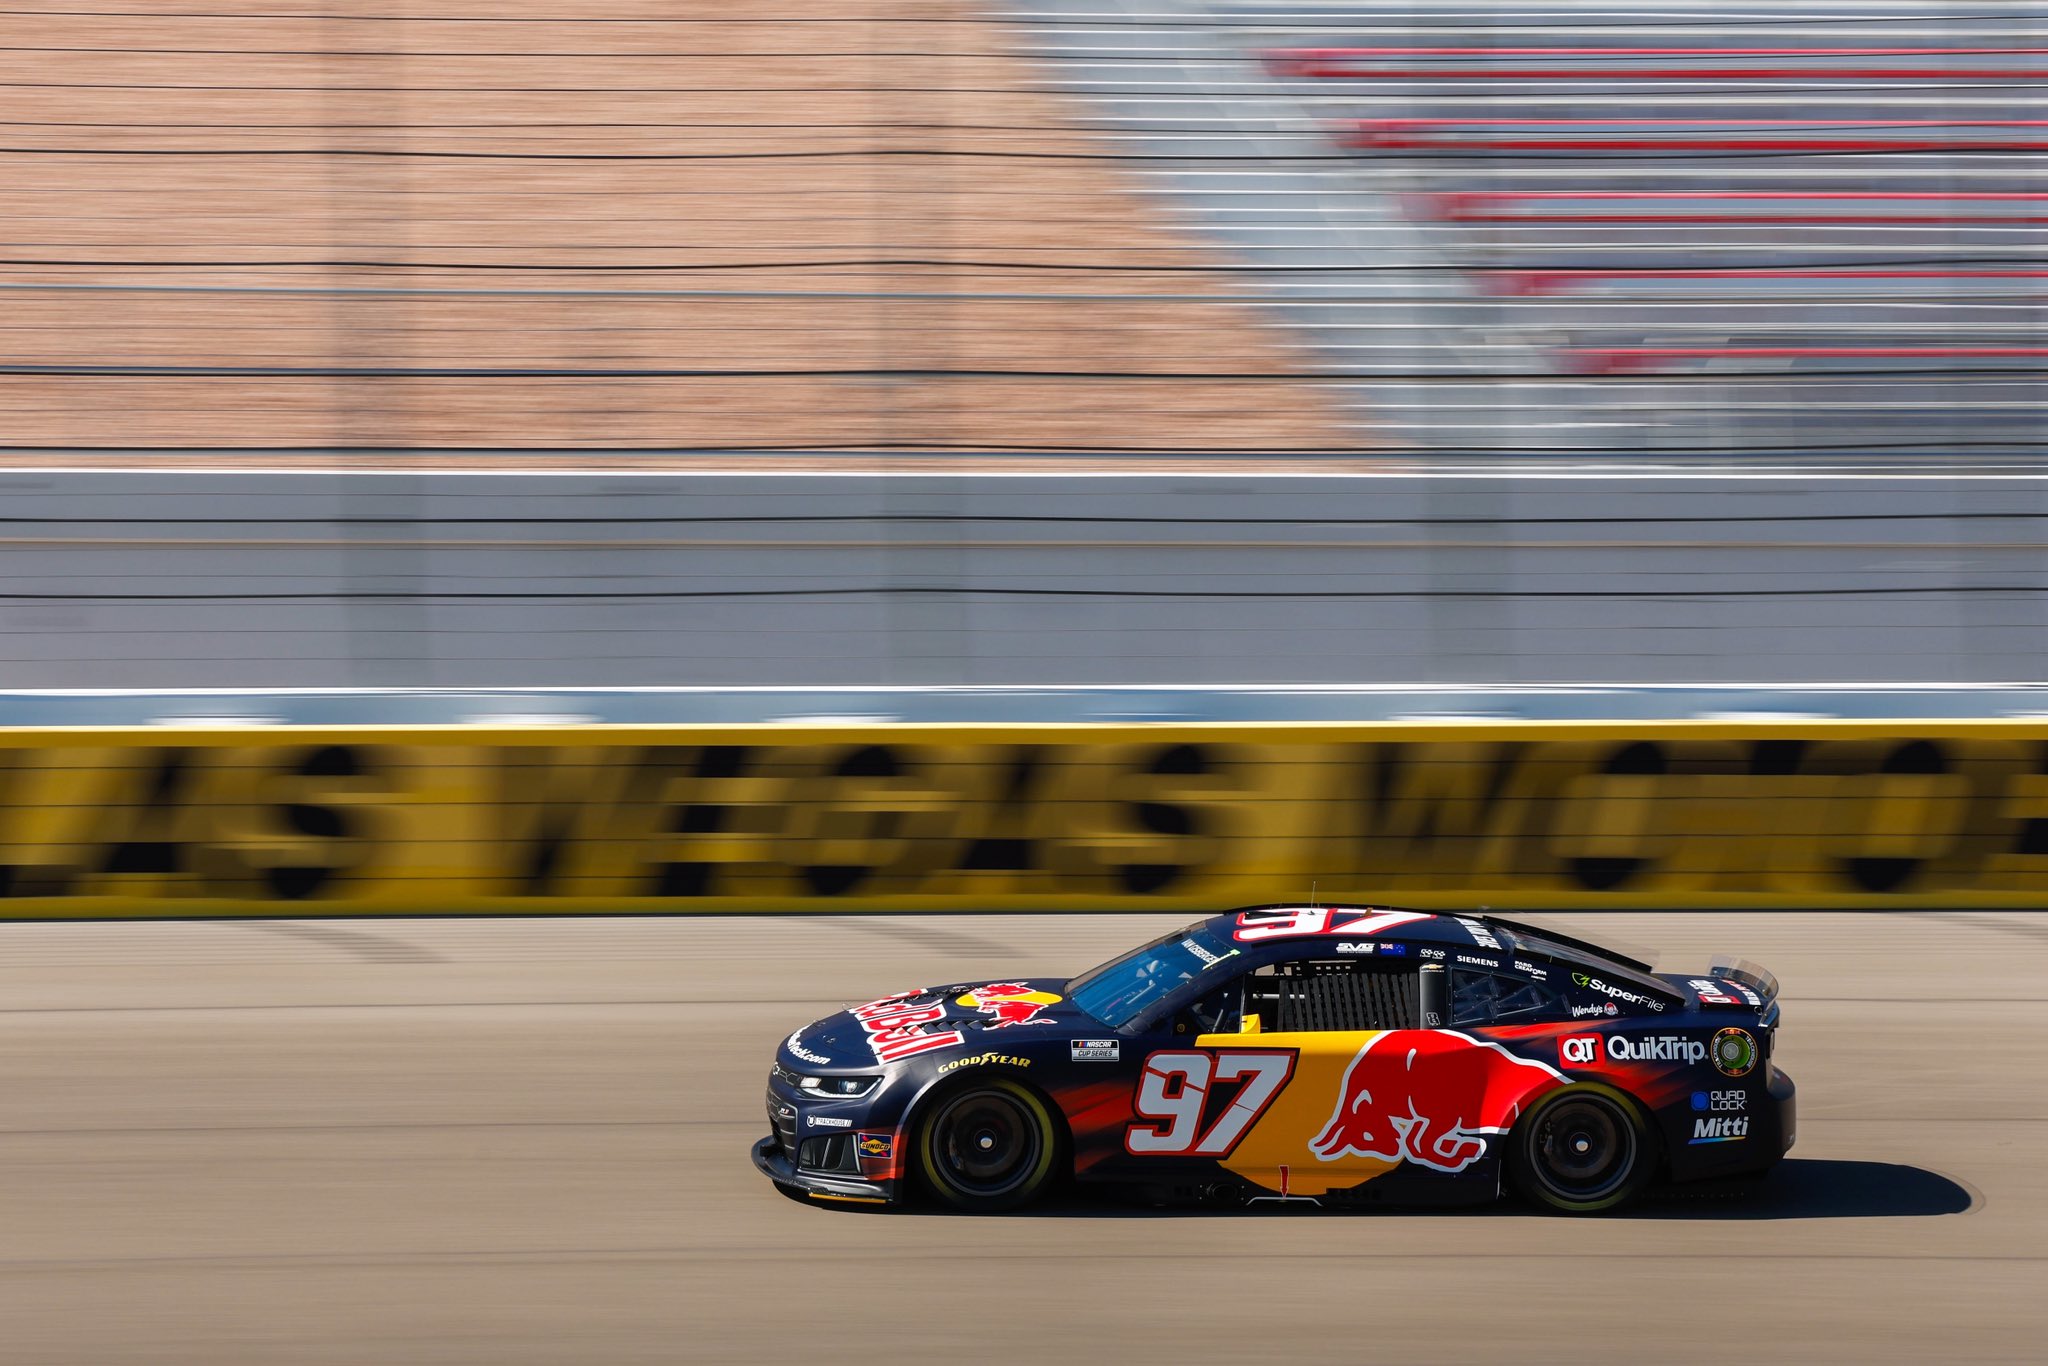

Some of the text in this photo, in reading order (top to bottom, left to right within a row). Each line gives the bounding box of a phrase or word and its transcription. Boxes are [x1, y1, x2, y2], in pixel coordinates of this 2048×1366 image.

[1233, 908, 1437, 942] 97
[1456, 955, 1499, 968] SIEMENS
[1589, 979, 1663, 1012] SuperFile
[1572, 1003, 1603, 1018] Wendy's
[1563, 1037, 1597, 1063] QT
[938, 1052, 1031, 1074] GOODYEAR
[1124, 1049, 1298, 1157] 97
[1710, 1090, 1746, 1101] QUAD
[1710, 1100, 1746, 1111] LOCK
[1693, 1116, 1749, 1138] Mitti
[861, 1141, 891, 1151] SUNOCO
